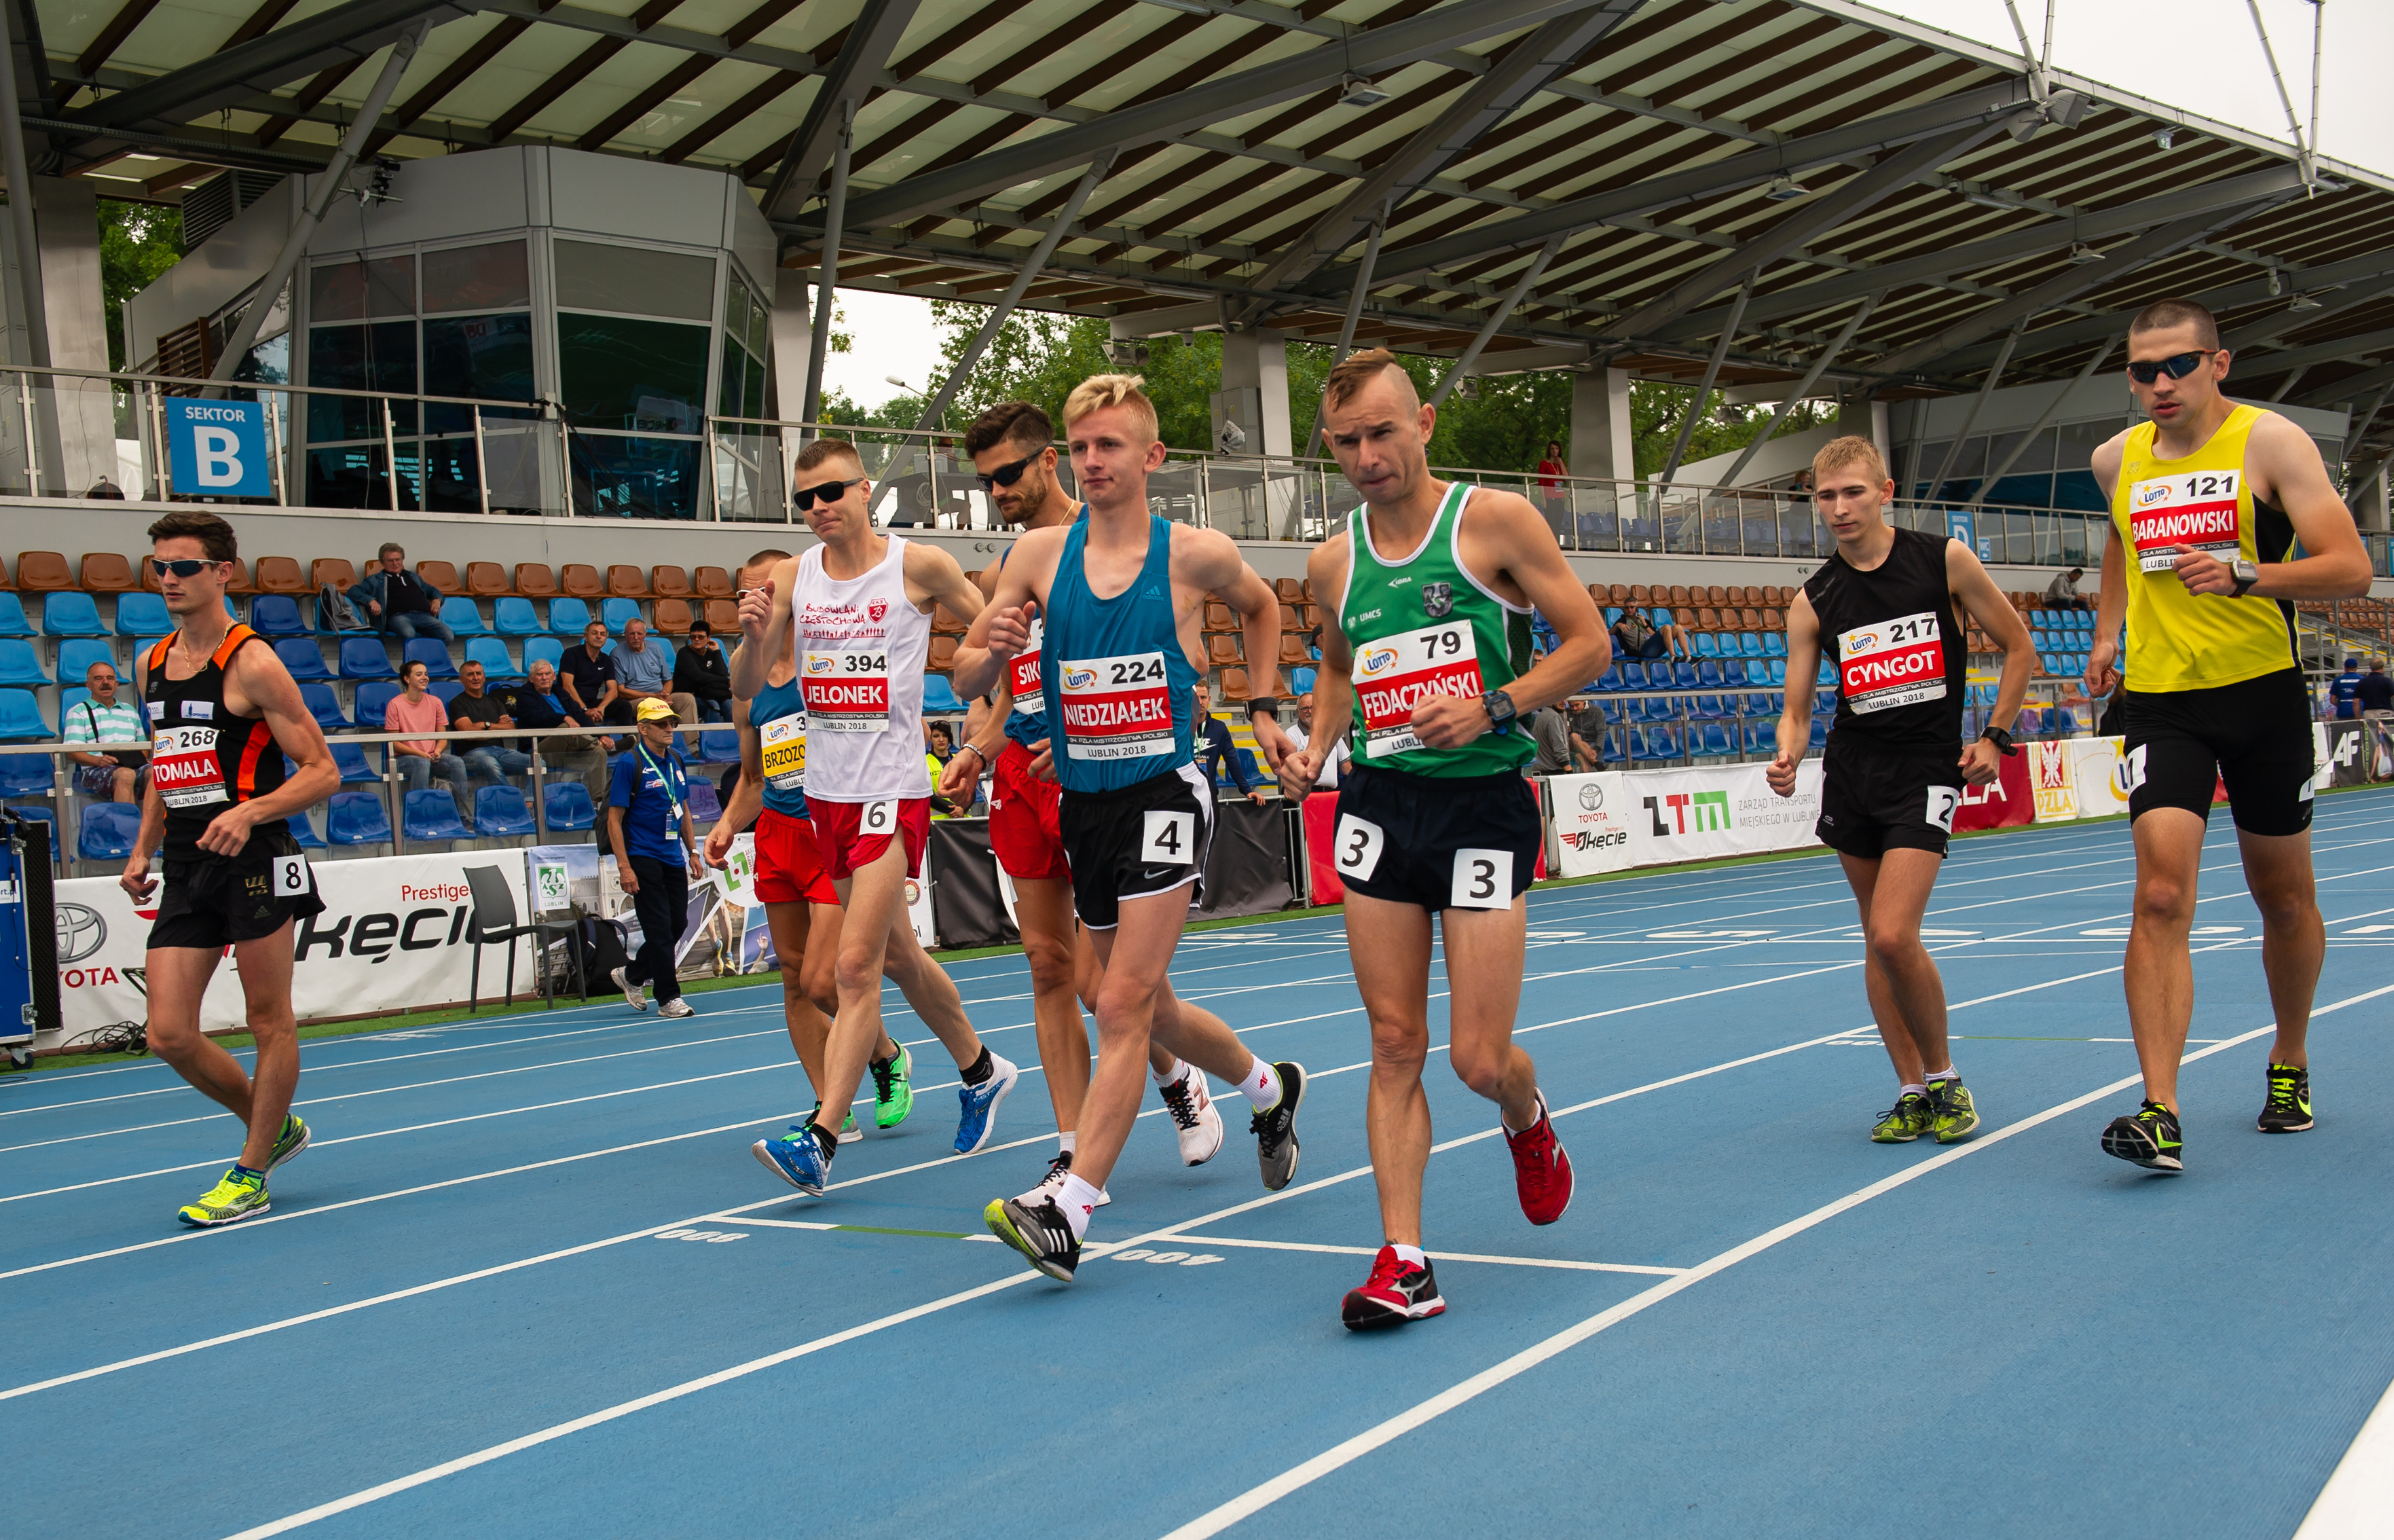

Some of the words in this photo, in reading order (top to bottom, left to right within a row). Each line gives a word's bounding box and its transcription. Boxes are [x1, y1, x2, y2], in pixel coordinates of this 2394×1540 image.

[185, 406, 246, 422] SEKTOR
[194, 426, 243, 487] B
[2145, 489, 2165, 502] LOTTO
[2186, 476, 2234, 497] 121
[2133, 510, 2234, 543] BARANOWSKI
[1979, 542, 1989, 551] WC
[2146, 559, 2176, 568] LUBLI
[1360, 608, 1381, 622] UMCS
[1852, 637, 1871, 650] LOTTO
[1890, 618, 1935, 643] 217
[1367, 653, 1391, 670] LOTTO
[1420, 631, 1461, 659] 79
[812, 661, 828, 670] LOTTO
[845, 655, 887, 672] 394
[1018, 660, 1041, 684] SIK
[1068, 673, 1090, 686] LOTTO
[1111, 659, 1164, 684] 224
[1847, 650, 1935, 686] CYNGOT
[807, 686, 883, 704] JELONEK
[1875, 684, 1920, 695] MISTRZOSTWA
[1032, 701, 1044, 710] LUB
[1868, 697, 1900, 709] LUBLIN
[1903, 693, 1925, 703] 2018
[1064, 697, 1166, 727] NIEDZIAŁEK
[155, 739, 170, 750] LOTTO
[180, 730, 215, 748] 268
[771, 727, 784, 738] LOTTO
[1093, 735, 1141, 744] MISTRZOSTWA
[1382, 729, 1400, 737] PZLA
[1088, 748, 1119, 757] LUBLIN
[1123, 746, 1147, 756] 2018
[2334, 731, 2360, 767] 4F
[154, 758, 217, 782] TOMALA
[786, 777, 805, 787] LUBLI
[191, 795, 207, 803] 2018
[1738, 798, 1767, 811] ZARZĄD
[1770, 794, 1816, 807] TRANSPORTU
[2038, 791, 2074, 815] PZLA
[868, 802, 885, 828] 6
[1579, 812, 1608, 824] TOYOTA
[1939, 794, 1954, 825] 2
[1739, 813, 1780, 828] MIEJSKIEGO
[1782, 813, 1790, 823] W
[1155, 820, 1181, 855] 4
[1342, 828, 1369, 867] 3
[286, 862, 301, 889] 8
[1469, 860, 1495, 899] 3
[402, 884, 471, 902] Prestige
[809, 1152, 822, 1186] saucony
